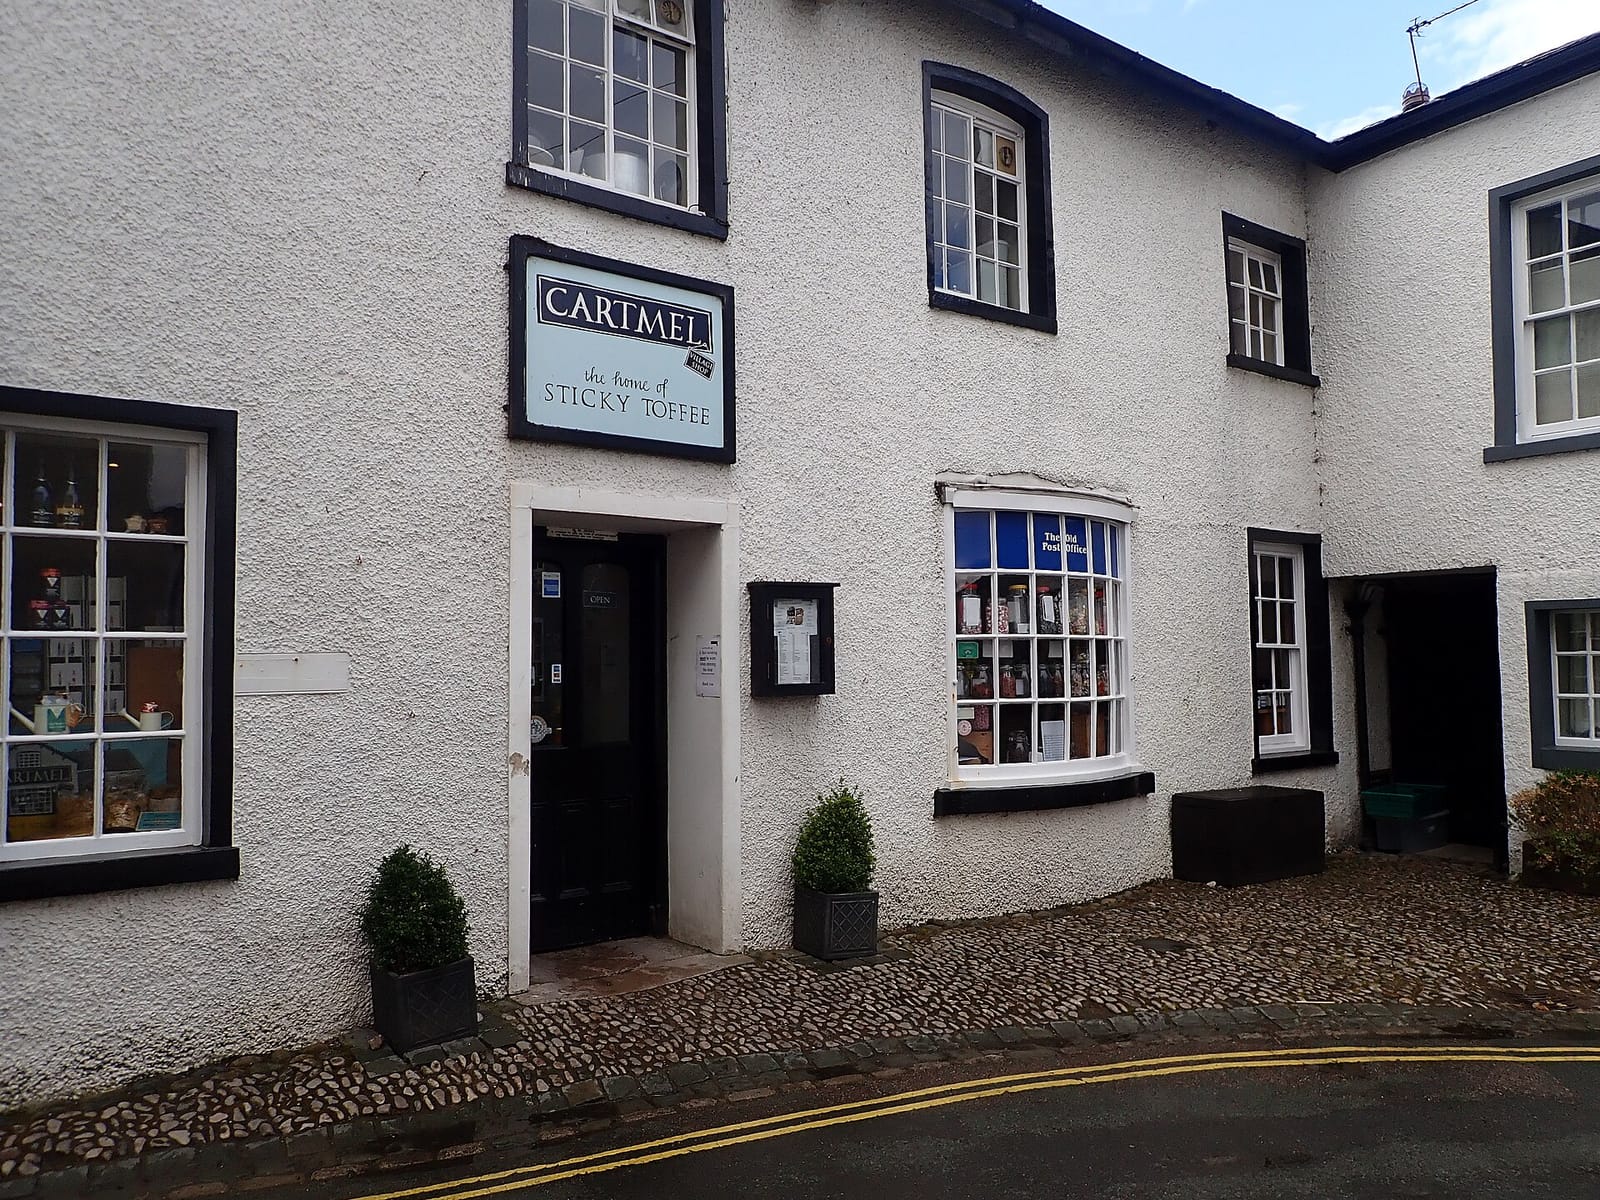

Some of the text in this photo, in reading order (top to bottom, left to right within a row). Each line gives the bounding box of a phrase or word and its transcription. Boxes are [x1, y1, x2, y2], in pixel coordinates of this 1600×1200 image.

[545, 287, 702, 346] CARTMEL
[691, 361, 709, 375] SHOP
[584, 366, 669, 399] the home of
[544, 383, 710, 426] STICKY TOFFEE
[1044, 532, 1078, 543] The Old
[1042, 542, 1088, 554] Post Office
[590, 595, 611, 604] OPEN
